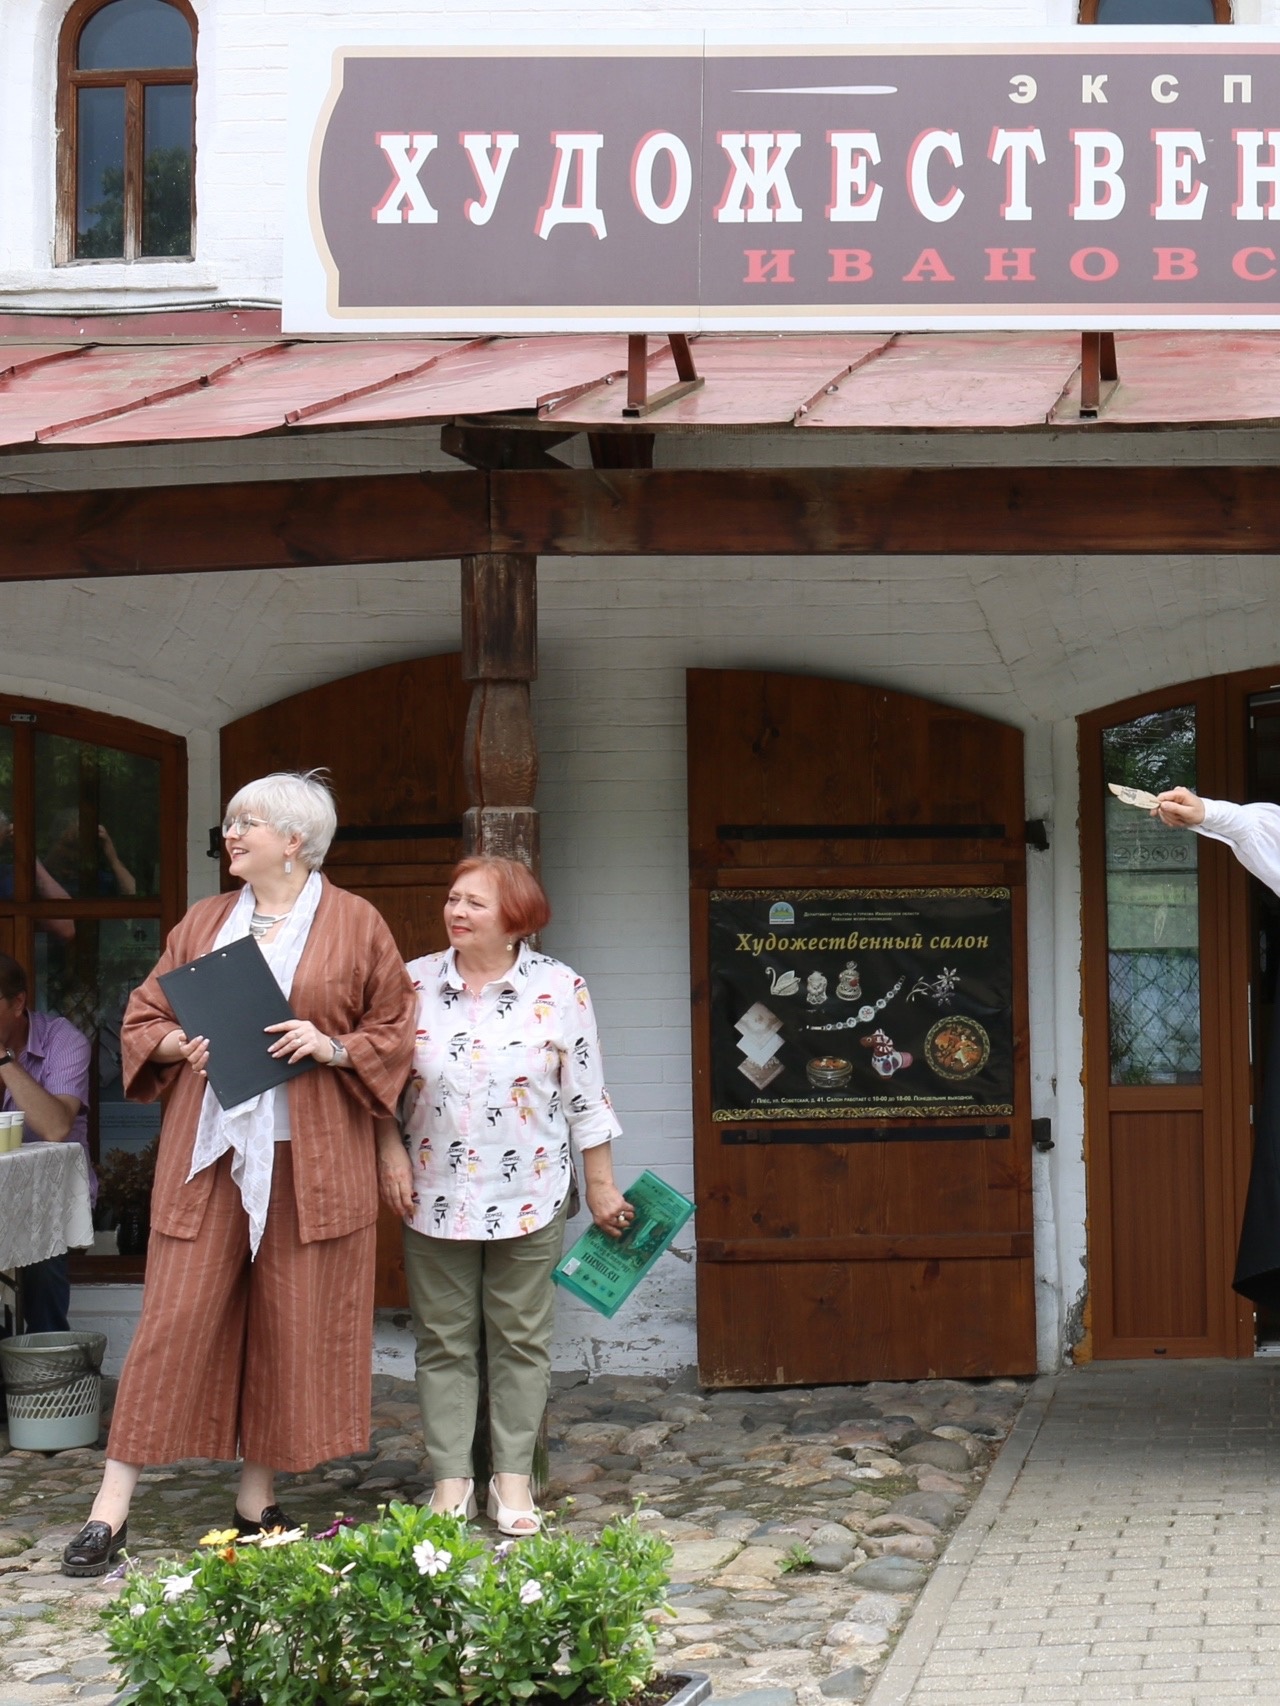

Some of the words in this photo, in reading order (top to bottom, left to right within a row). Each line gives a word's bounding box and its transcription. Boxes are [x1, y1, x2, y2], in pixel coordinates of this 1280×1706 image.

[736, 932, 923, 956] Художественный
[930, 933, 989, 950] салон
[581, 1252, 620, 1283] ПУШКИН
